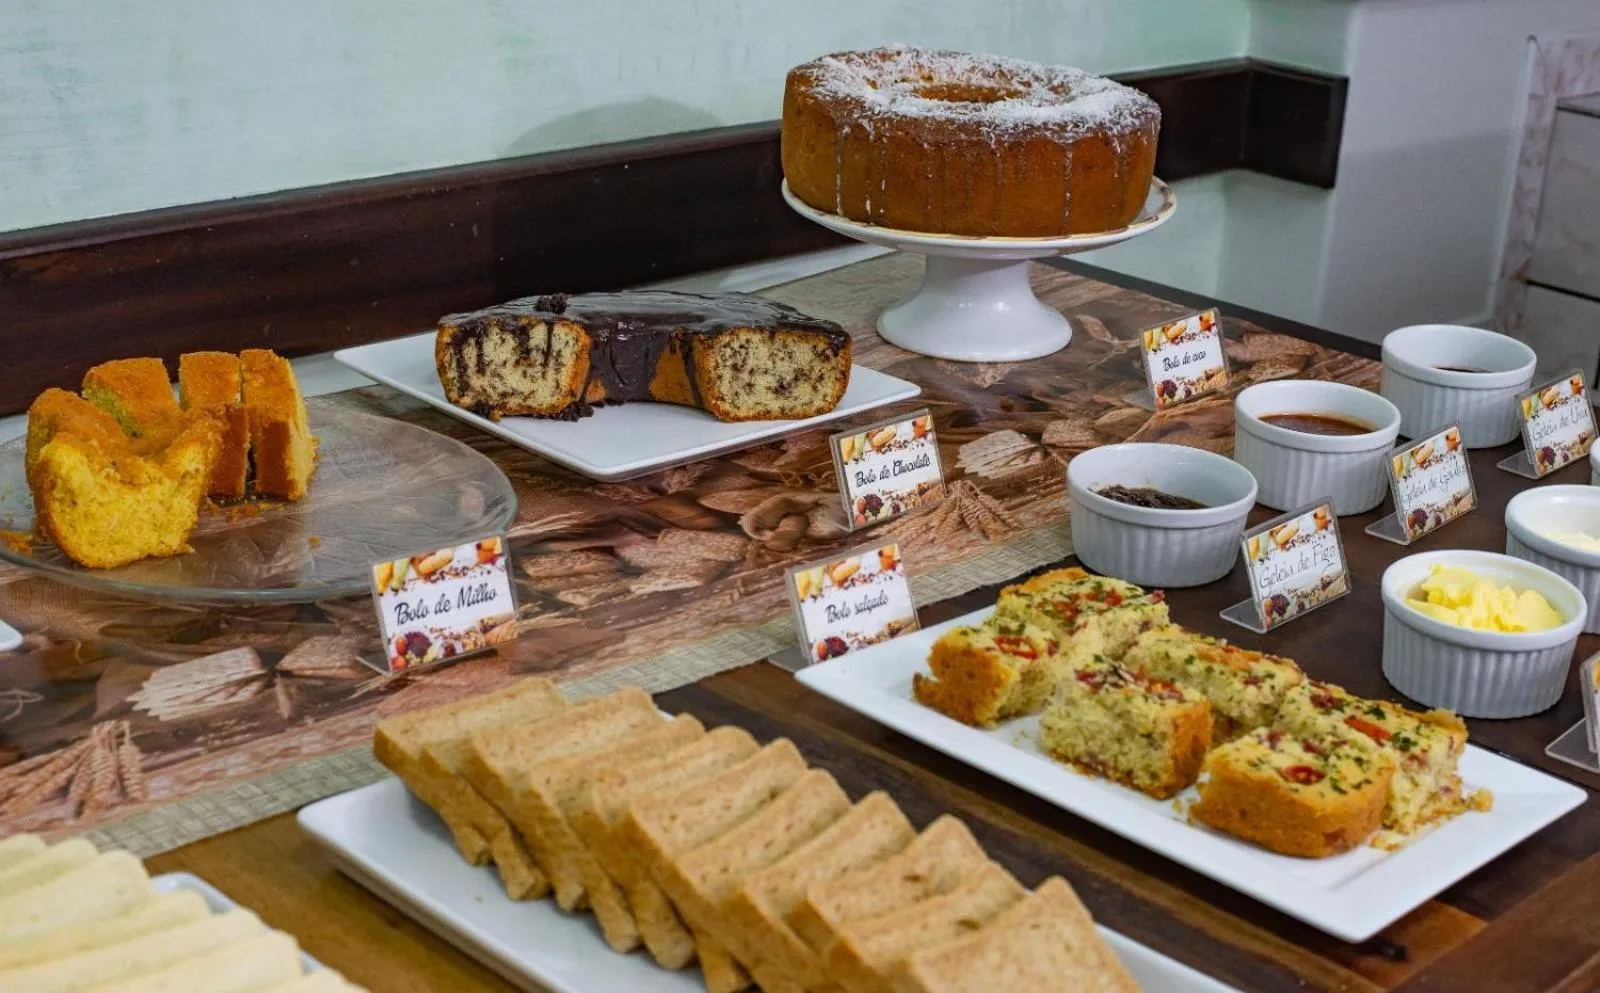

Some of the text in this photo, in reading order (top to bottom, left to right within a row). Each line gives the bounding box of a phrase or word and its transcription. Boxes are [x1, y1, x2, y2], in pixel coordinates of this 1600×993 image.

[1162, 354, 1181, 372] Bolo
[1182, 352, 1192, 366] de
[854, 453, 931, 488] Bolo de Chocolate
[1260, 560, 1295, 590] Geleia
[1298, 552, 1310, 573] de
[394, 582, 498, 627] Bolo de Milho
[824, 589, 890, 625] Bolo salgado
